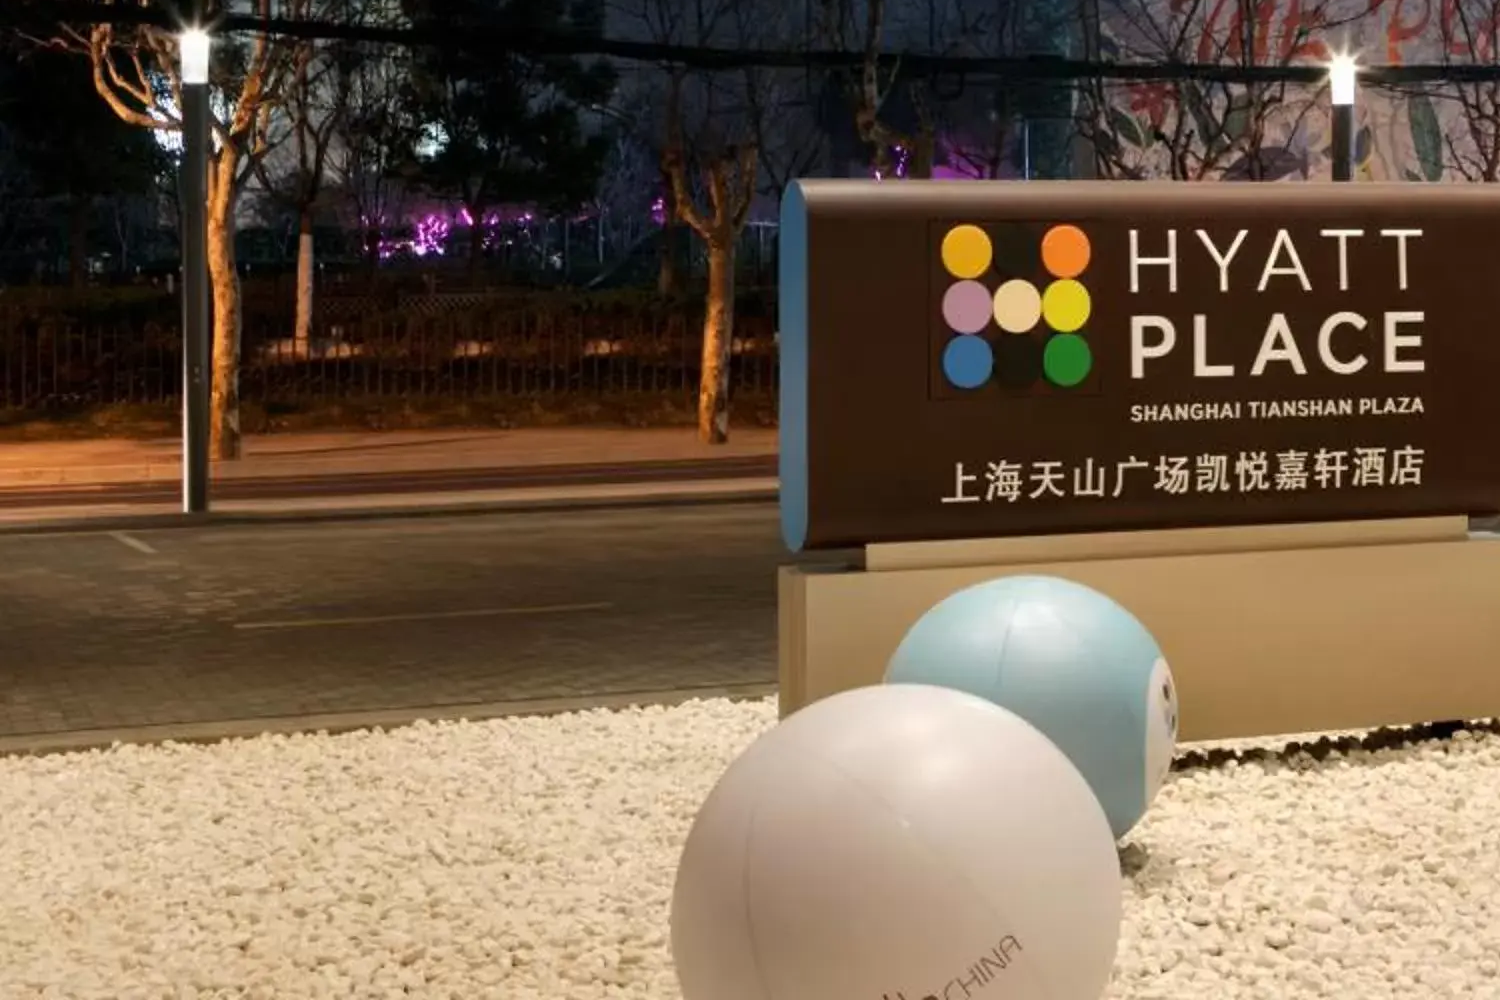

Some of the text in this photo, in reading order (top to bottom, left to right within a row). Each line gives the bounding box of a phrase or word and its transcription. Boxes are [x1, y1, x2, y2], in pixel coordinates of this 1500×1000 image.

[1128, 228, 1424, 293] HYATT
[1129, 310, 1426, 379] PLACE
[1129, 396, 1425, 423] SHANGHAI TIANSHAN PLAZA
[941, 445, 1425, 503] 上海天山广场凯悦嘉轩酒店
